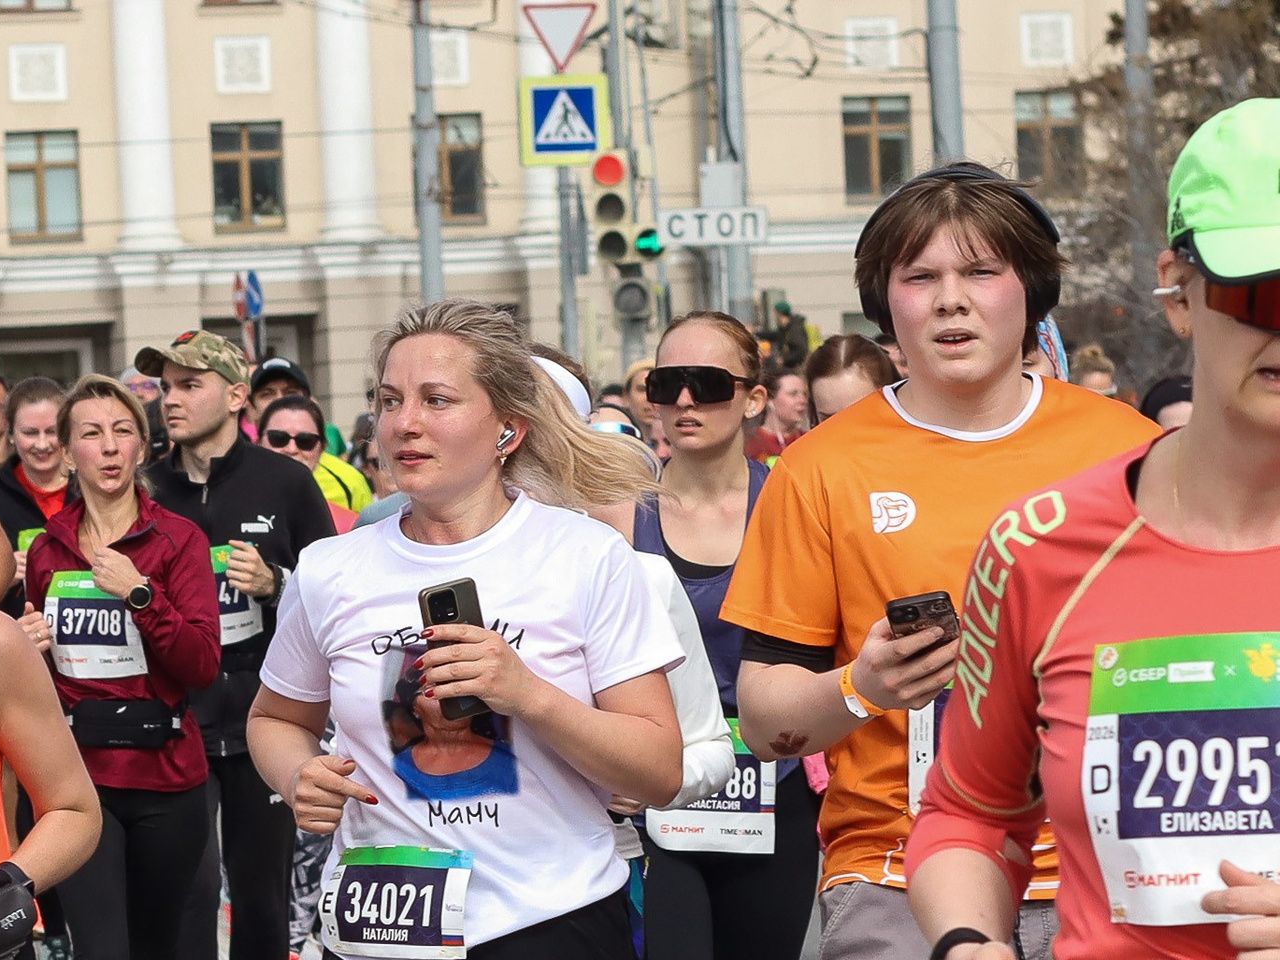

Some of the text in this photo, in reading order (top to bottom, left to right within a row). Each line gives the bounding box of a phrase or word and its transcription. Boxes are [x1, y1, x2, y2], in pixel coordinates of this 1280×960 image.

[668, 213, 758, 238] СТОП
[61, 607, 121, 636] 37708
[956, 490, 1067, 729] ADIZERO
[1091, 765, 1111, 794] D
[1132, 736, 1280, 809] 2995
[671, 826, 705, 834] МАГНИТ
[1160, 809, 1274, 834] ЕЛИЗАВЕТА
[322, 892, 334, 913] E
[344, 881, 434, 927] 34021
[362, 928, 409, 941] НАТАЛИЯ
